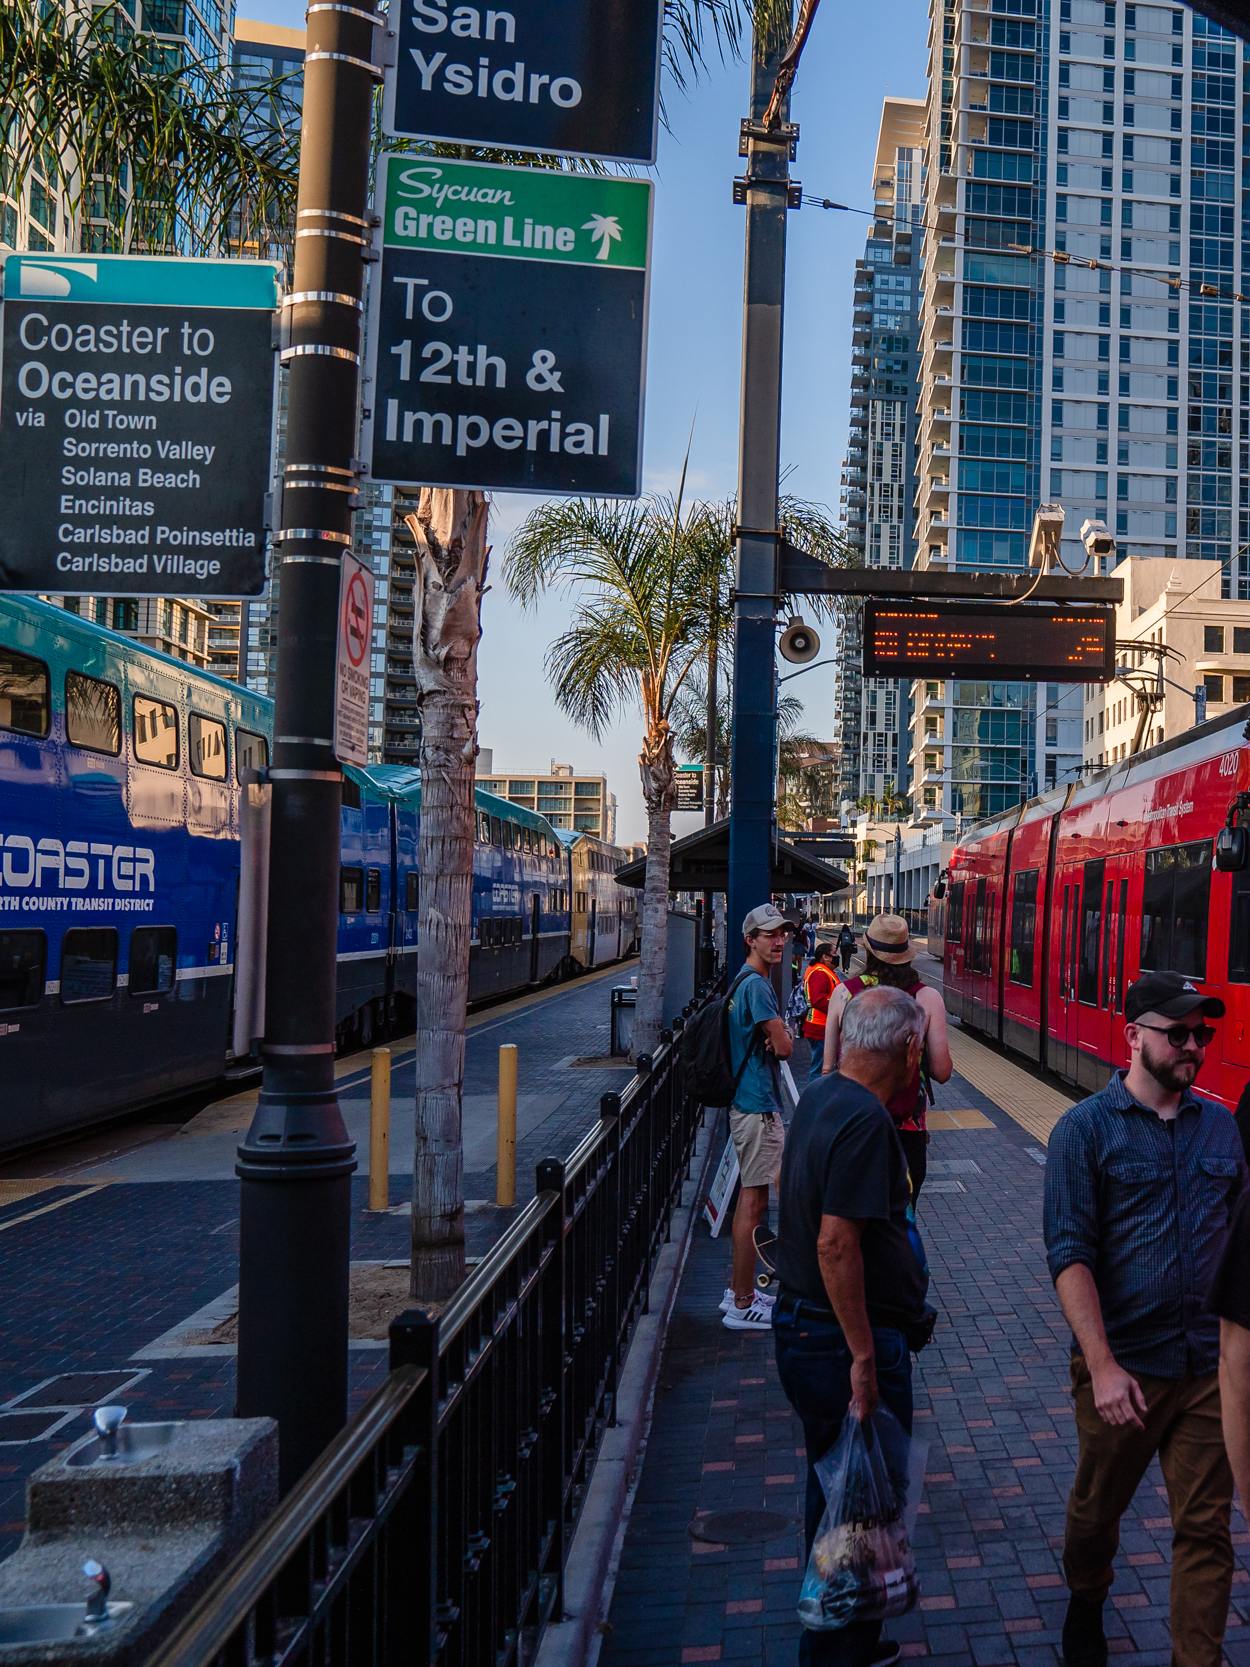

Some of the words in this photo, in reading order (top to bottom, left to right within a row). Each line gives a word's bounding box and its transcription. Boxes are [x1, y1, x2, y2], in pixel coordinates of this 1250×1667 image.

[412, 0, 516, 43] San
[409, 48, 583, 108] Ysidro
[396, 167, 516, 207] Sycuan
[393, 277, 454, 323] To
[19, 313, 169, 354] Coaster
[180, 322, 215, 355] to
[18, 361, 232, 403] Oceanside
[390, 339, 507, 388] 12th
[525, 349, 565, 393] &
[15, 411, 46, 427] via
[65, 408, 100, 429] Old
[105, 410, 157, 430] Town
[385, 398, 610, 457] Imperial
[63, 438, 152, 459] Sorrento
[156, 440, 216, 465] Valley
[61, 466, 132, 487] Solana
[138, 469, 201, 489] Beach
[60, 495, 155, 516] Encinitas
[58, 523, 150, 545] Carlsbad
[156, 526, 256, 547] Poinsettia
[56, 551, 148, 573] Carlsbad
[152, 554, 221, 580] Village
[1219, 752, 1239, 777] 4020
[0, 834, 155, 892] OASTER
[22, 896, 69, 910] COUNTY
[71, 897, 113, 911] TRANSIT
[115, 898, 154, 911] DISTRICT
